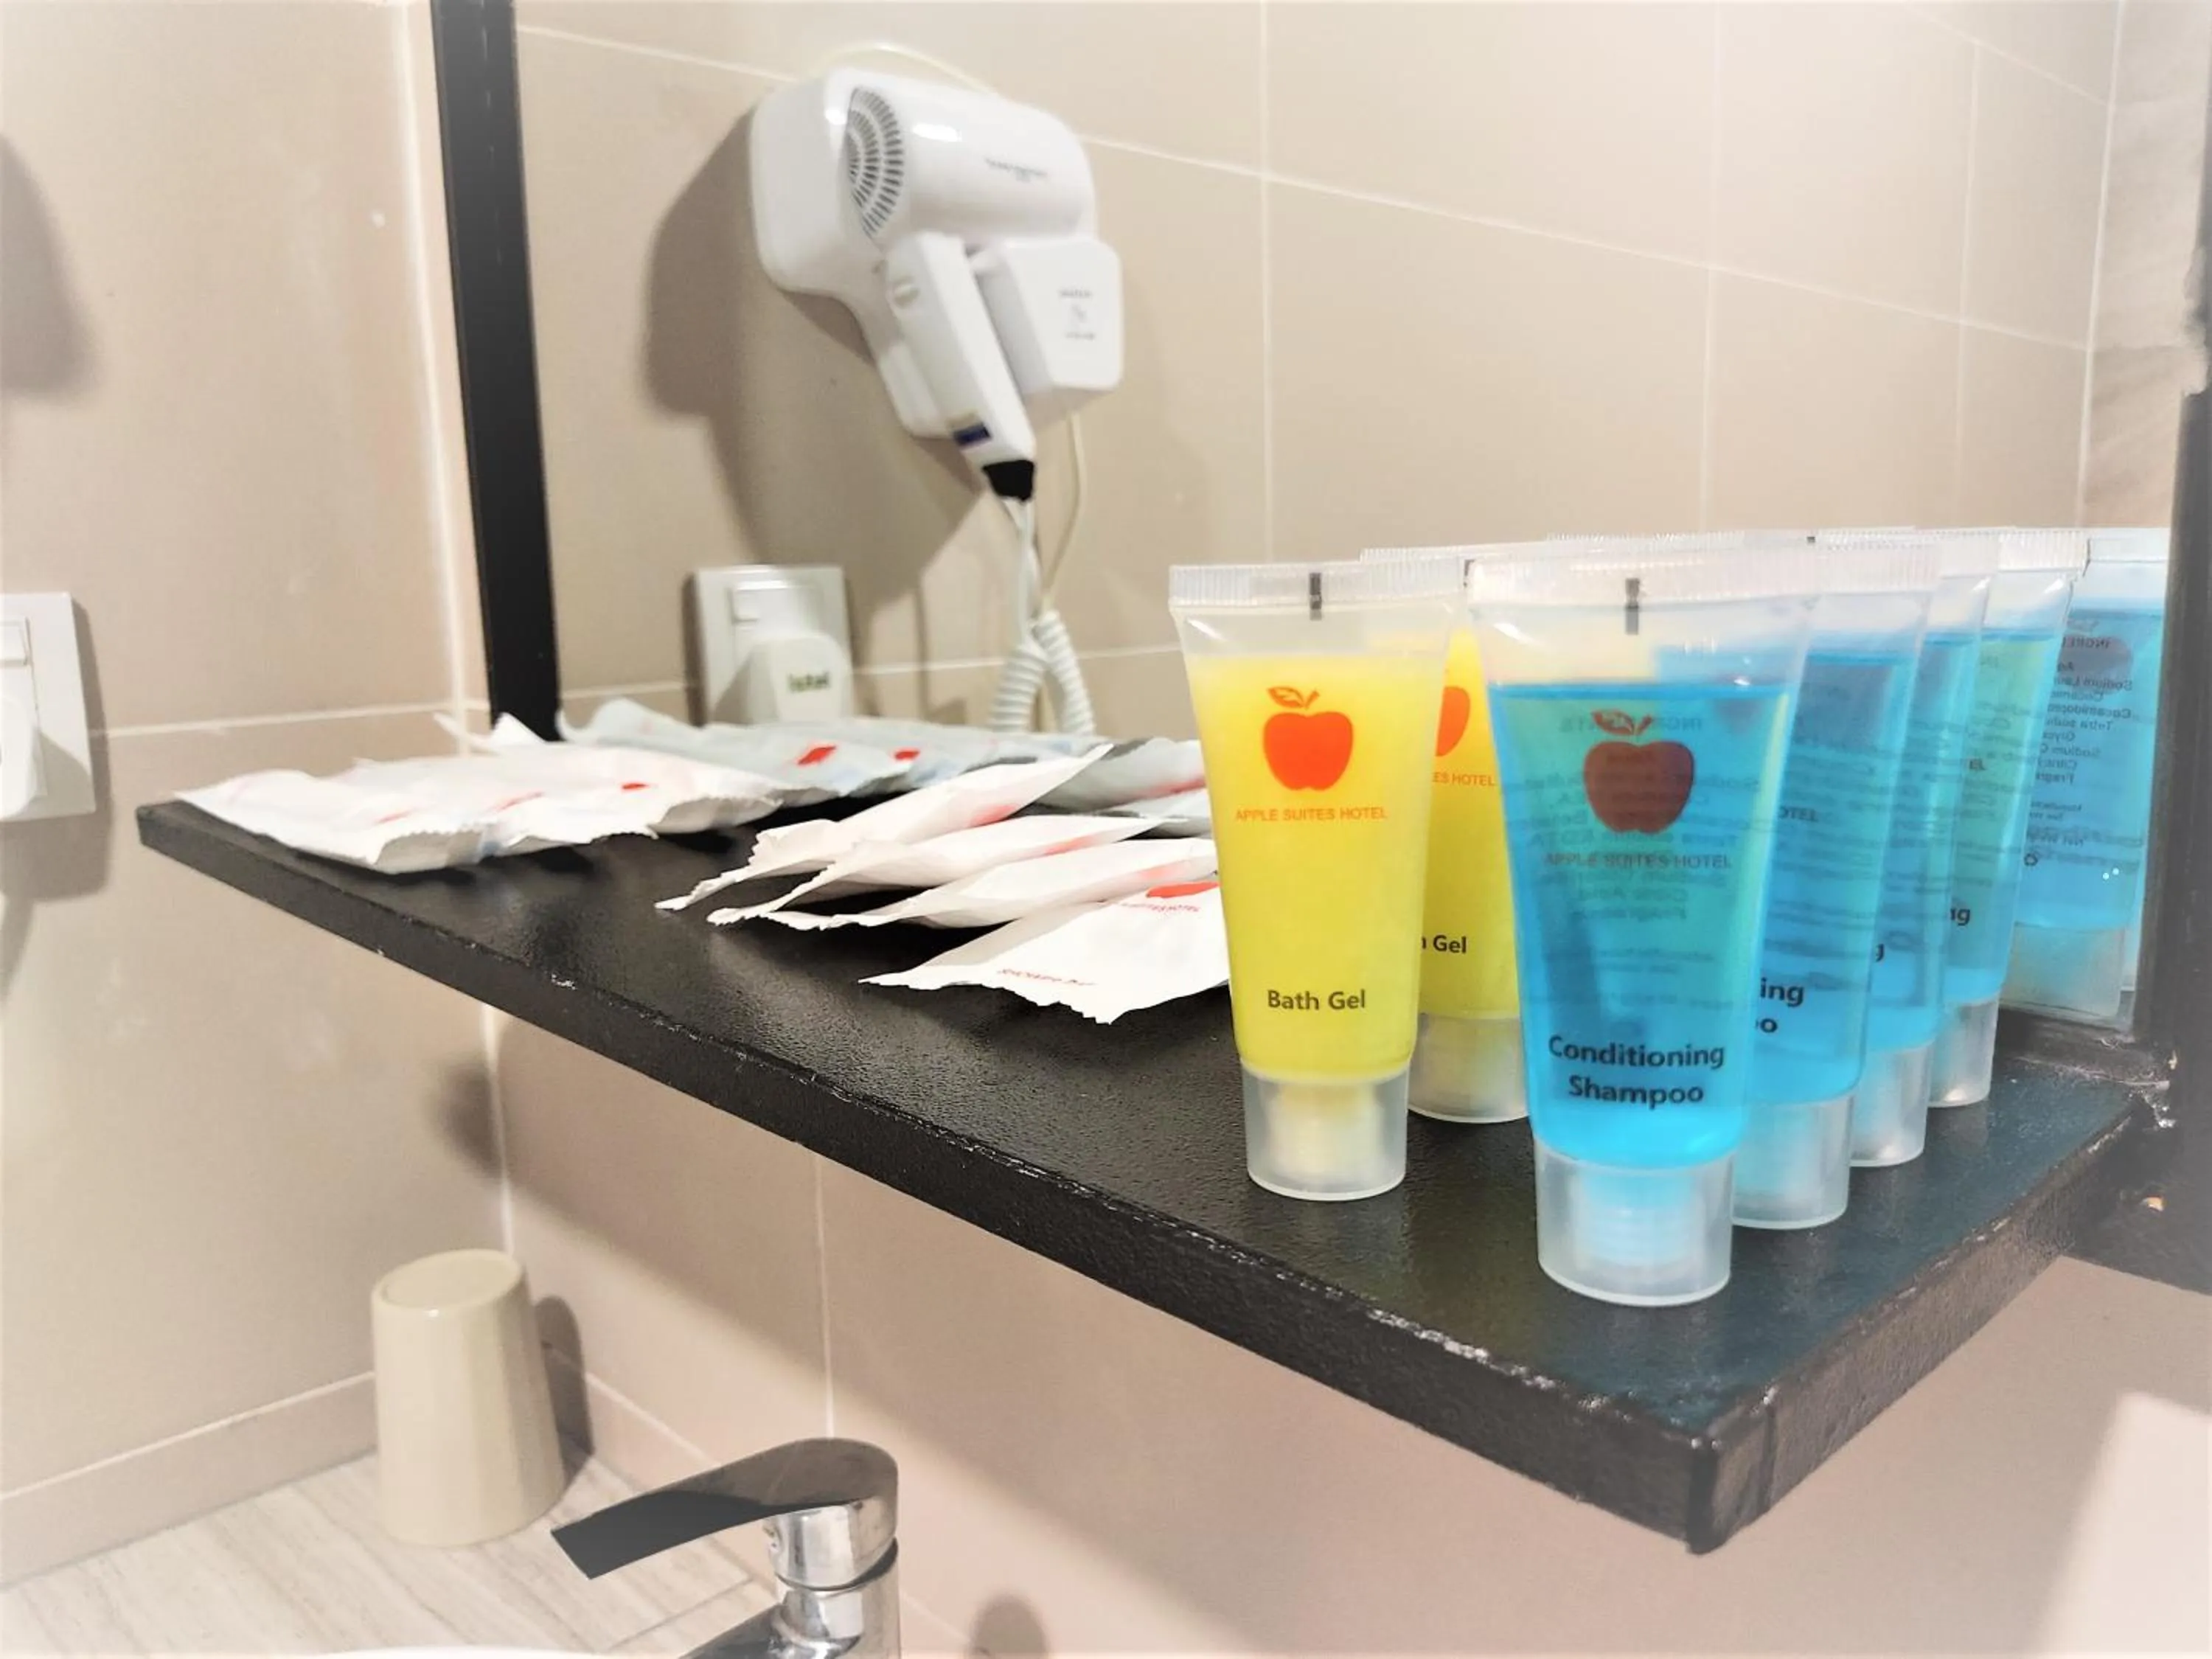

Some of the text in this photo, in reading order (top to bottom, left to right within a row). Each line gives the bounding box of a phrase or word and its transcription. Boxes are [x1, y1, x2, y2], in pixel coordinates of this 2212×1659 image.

[1452, 773, 1495, 787] HOTEL
[1235, 806, 1388, 821] APPLE SUITES HOTEL
[1777, 804, 1819, 824] OTEL
[1674, 854, 1732, 869] HOTEL
[1433, 934, 1467, 954] Gel
[1267, 987, 1366, 1010] Bath Gel
[1548, 1034, 1725, 1070] Conditioning
[1568, 1074, 1705, 1110] Shampoo
